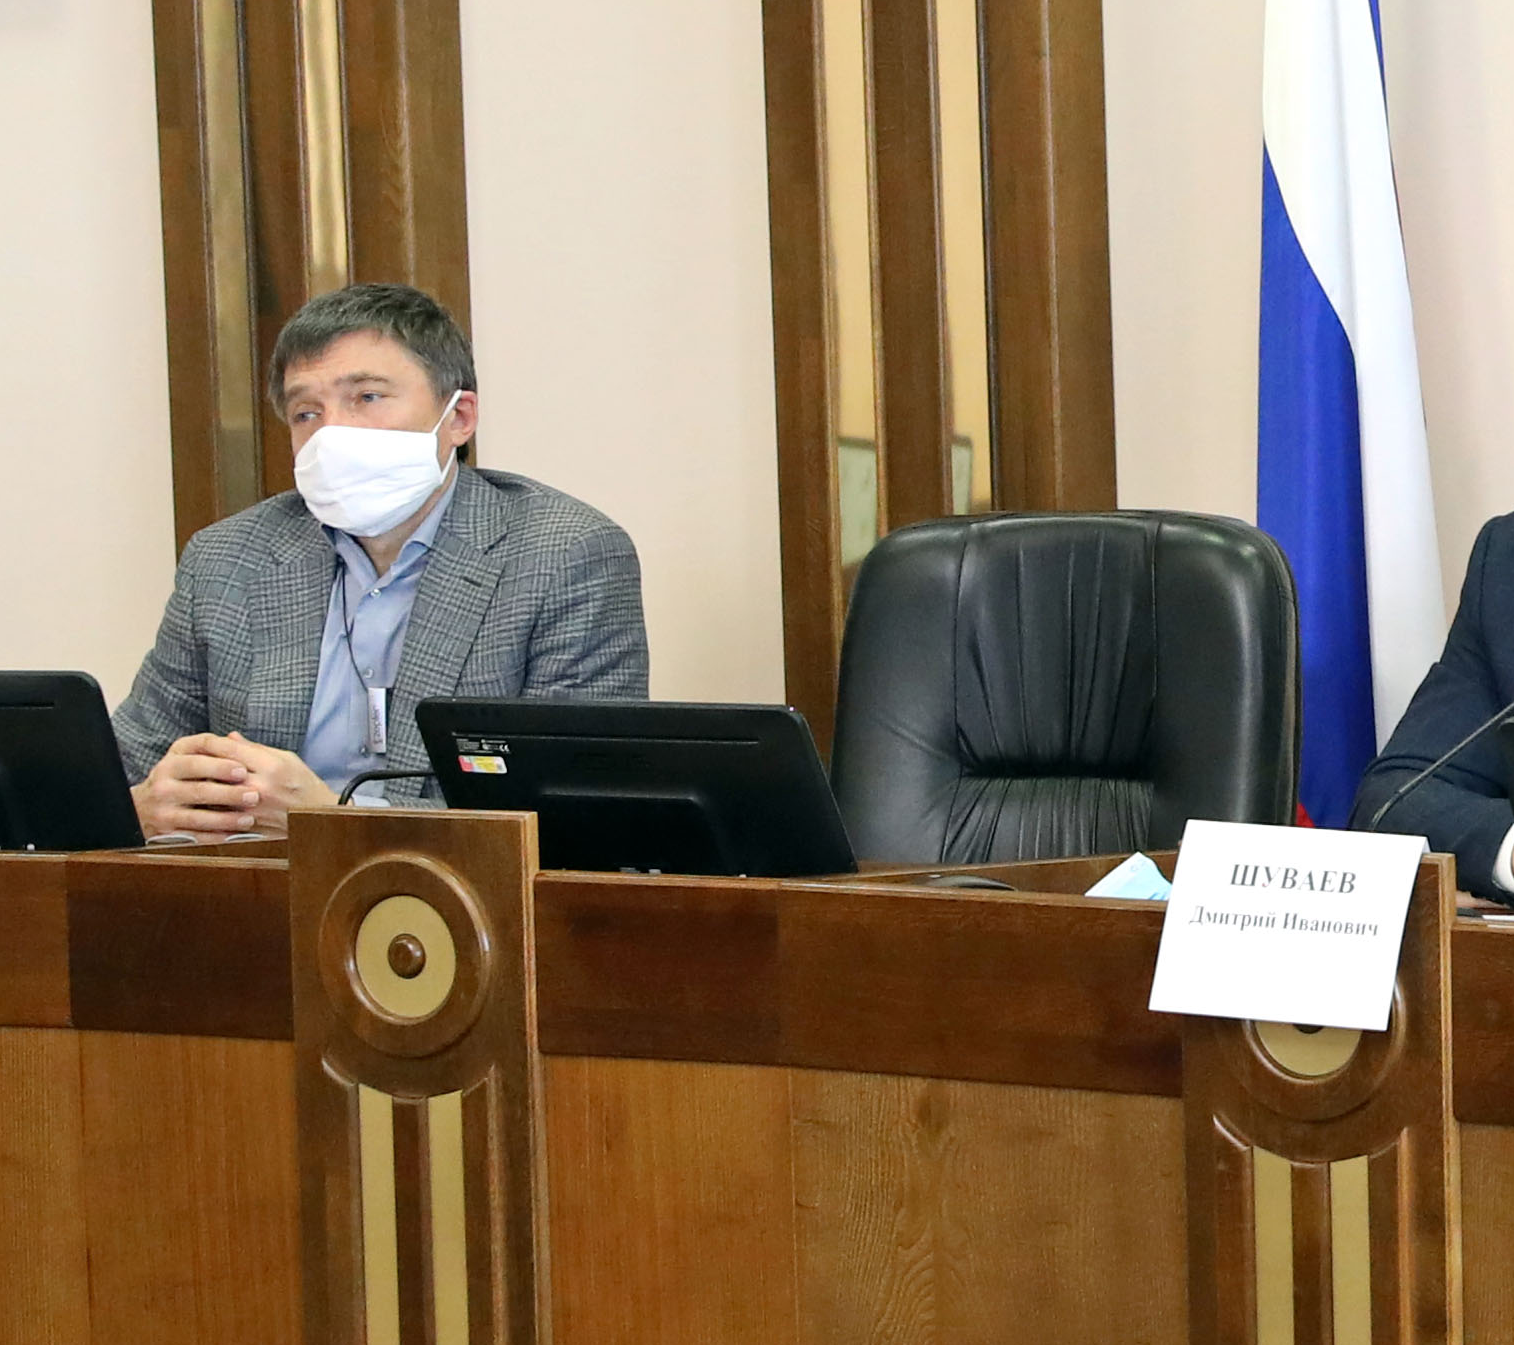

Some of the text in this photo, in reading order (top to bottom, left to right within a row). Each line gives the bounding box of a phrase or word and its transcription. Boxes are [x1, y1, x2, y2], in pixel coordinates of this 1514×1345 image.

[1229, 863, 1357, 894] ШУВАЕВ
[1188, 906, 1379, 937] Дмитрий Иванович
